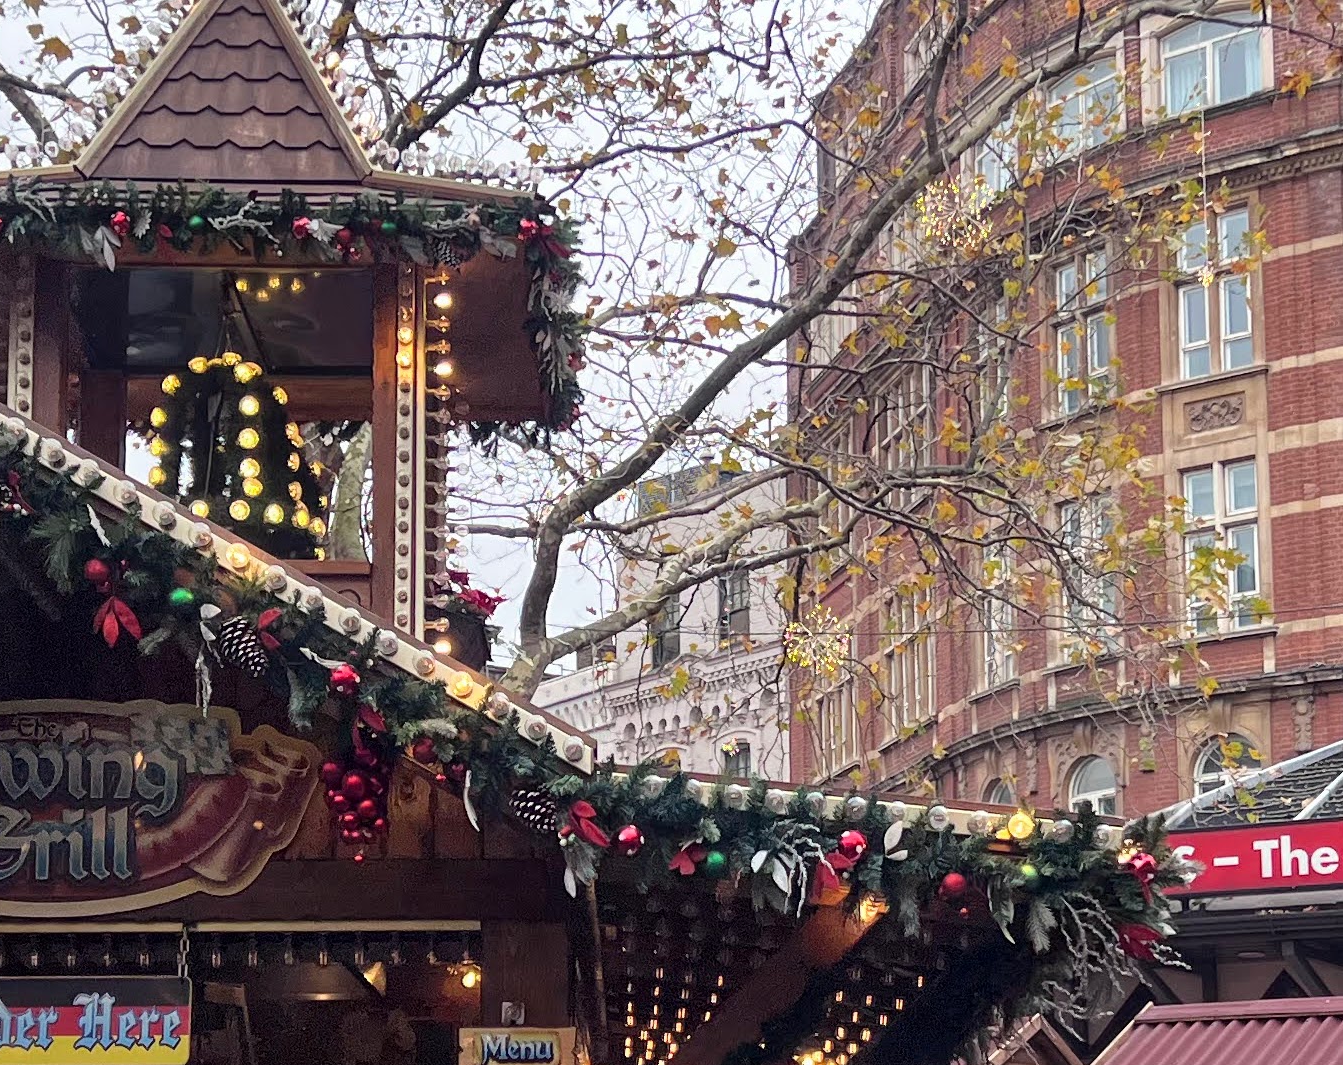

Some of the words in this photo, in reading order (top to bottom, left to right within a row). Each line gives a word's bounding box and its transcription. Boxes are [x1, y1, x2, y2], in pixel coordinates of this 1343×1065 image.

[15, 716, 59, 738] The
[1253, 835, 1340, 878] The
[72, 992, 183, 1053] Here
